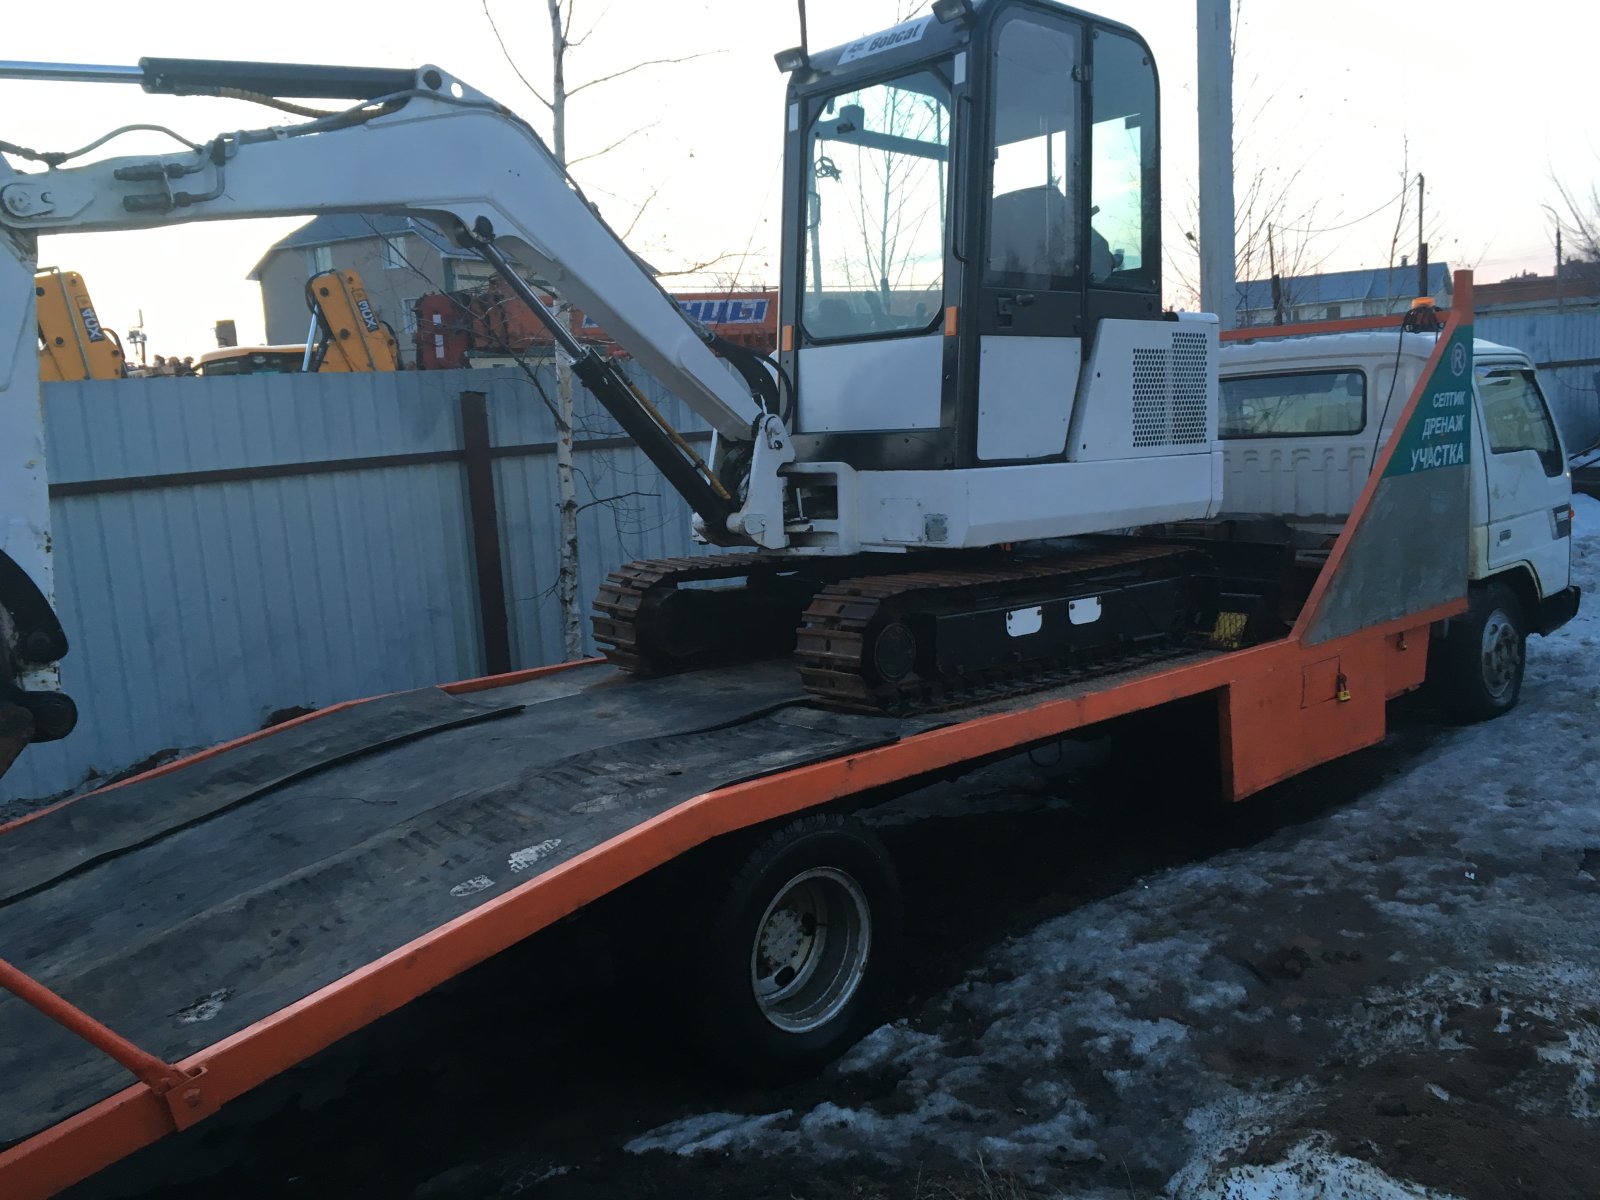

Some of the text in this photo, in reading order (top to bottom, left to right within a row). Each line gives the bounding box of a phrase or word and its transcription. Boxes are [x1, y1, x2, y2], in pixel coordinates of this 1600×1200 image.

[868, 24, 921, 51] Bobcat
[1432, 391, 1466, 408] СЕПТИК
[1422, 415, 1465, 440] ДРЕНАЖ
[1411, 443, 1464, 471] УЧАСТКА
